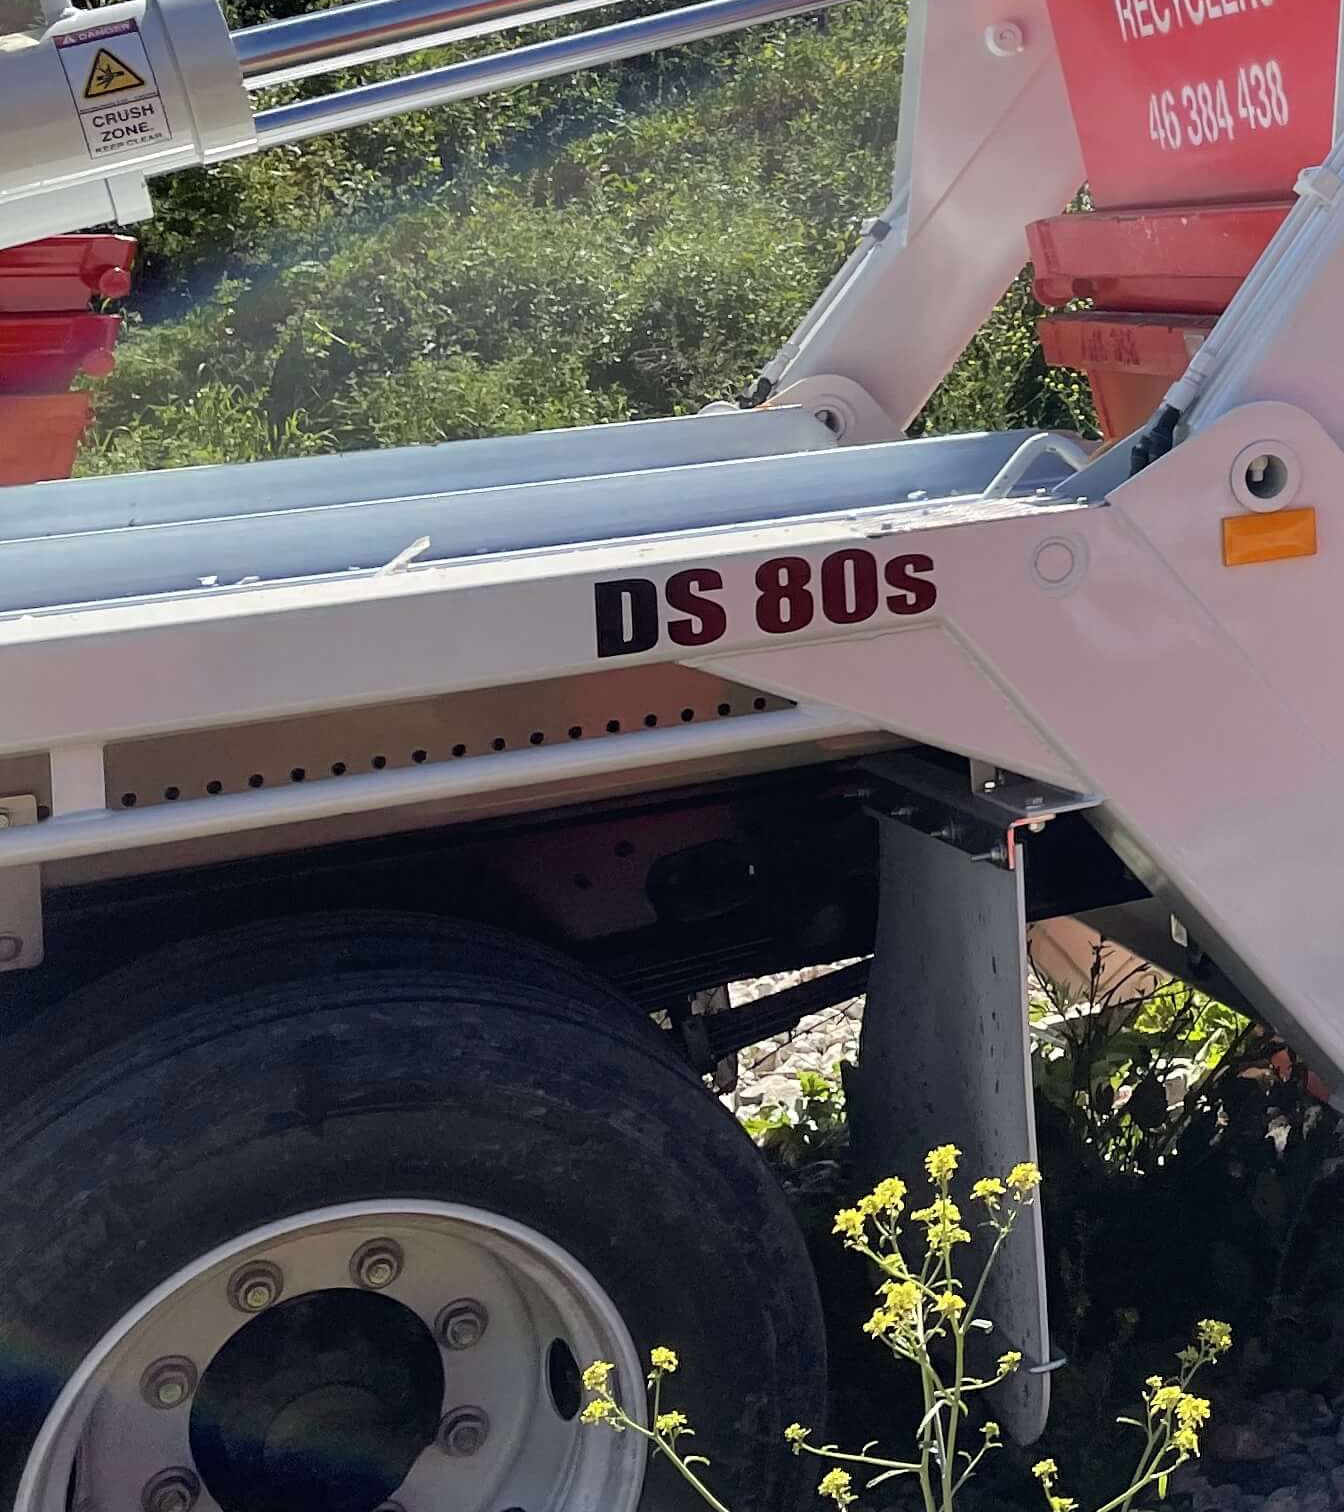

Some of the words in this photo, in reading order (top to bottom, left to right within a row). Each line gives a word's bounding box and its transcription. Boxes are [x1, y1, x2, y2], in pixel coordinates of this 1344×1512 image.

[92, 104, 154, 128] CRUSH
[1150, 90, 1181, 151] 46
[1182, 79, 1234, 147] 384
[1237, 60, 1288, 129] 438
[594, 568, 727, 658] DS
